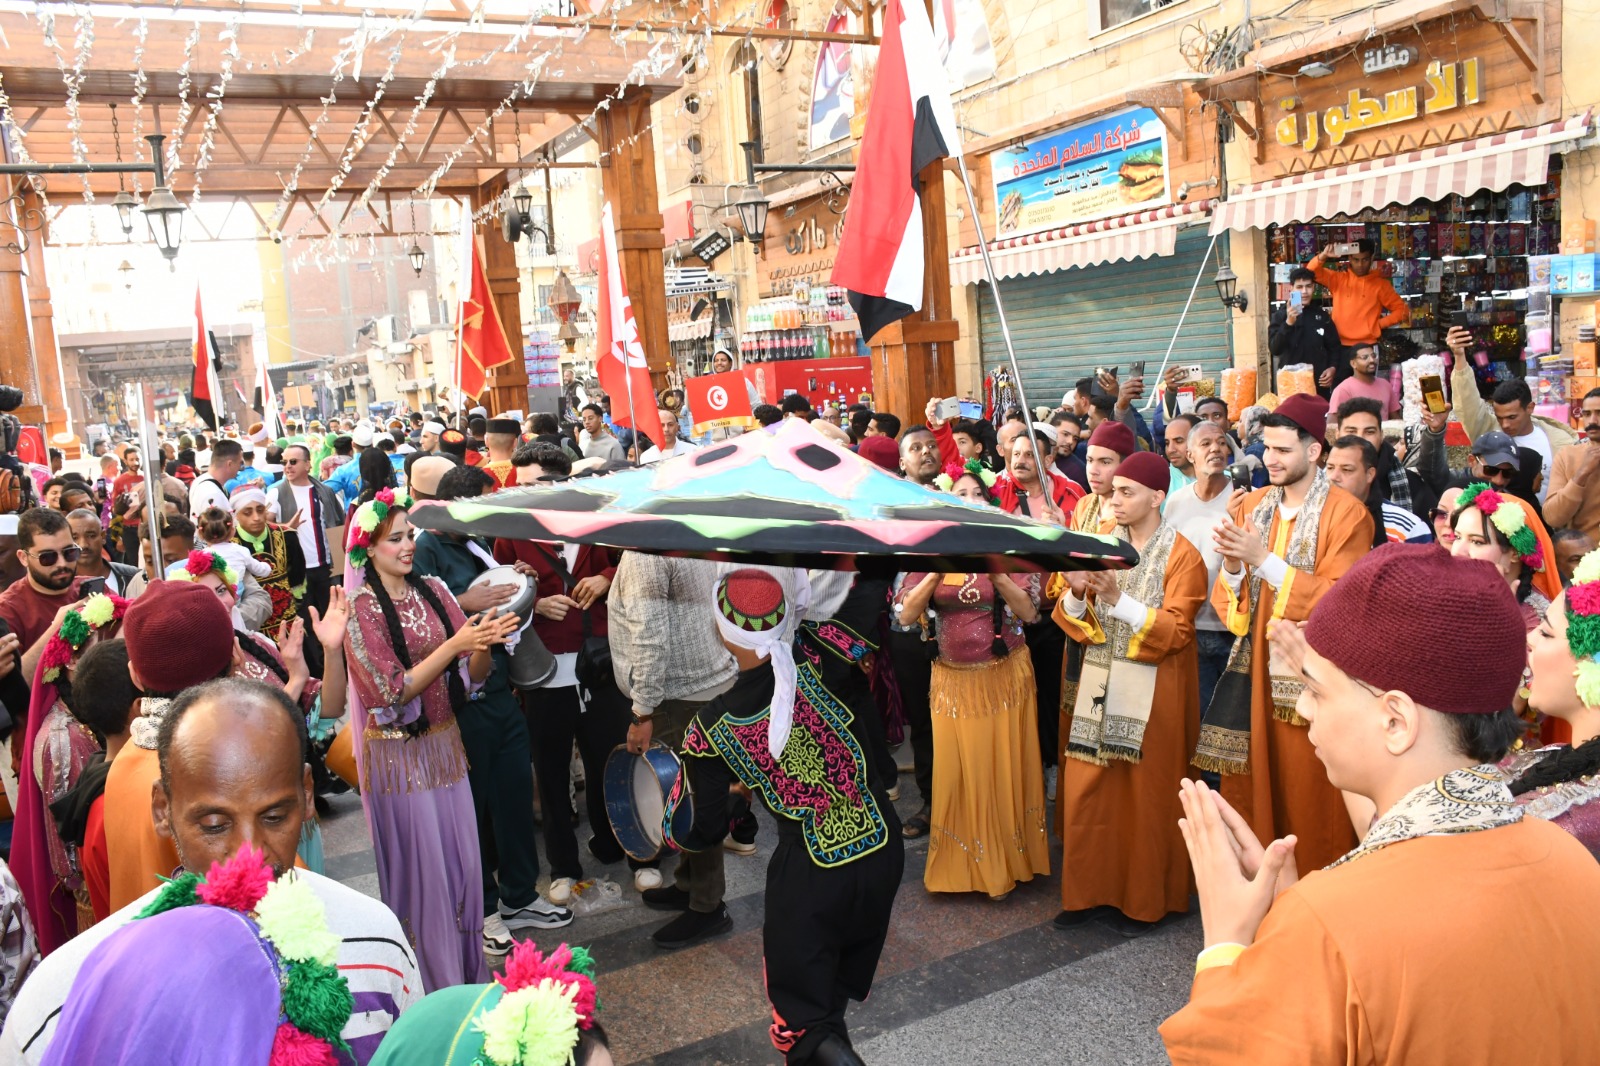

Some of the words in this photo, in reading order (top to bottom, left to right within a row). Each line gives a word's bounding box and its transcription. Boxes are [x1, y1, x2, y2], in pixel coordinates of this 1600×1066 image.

[1363, 45, 1412, 74] مقلة
[1275, 57, 1481, 152] الأسطورة
[1104, 119, 1142, 150] شركة
[1012, 147, 1059, 177] المتحدة
[1060, 132, 1103, 170] السلام
